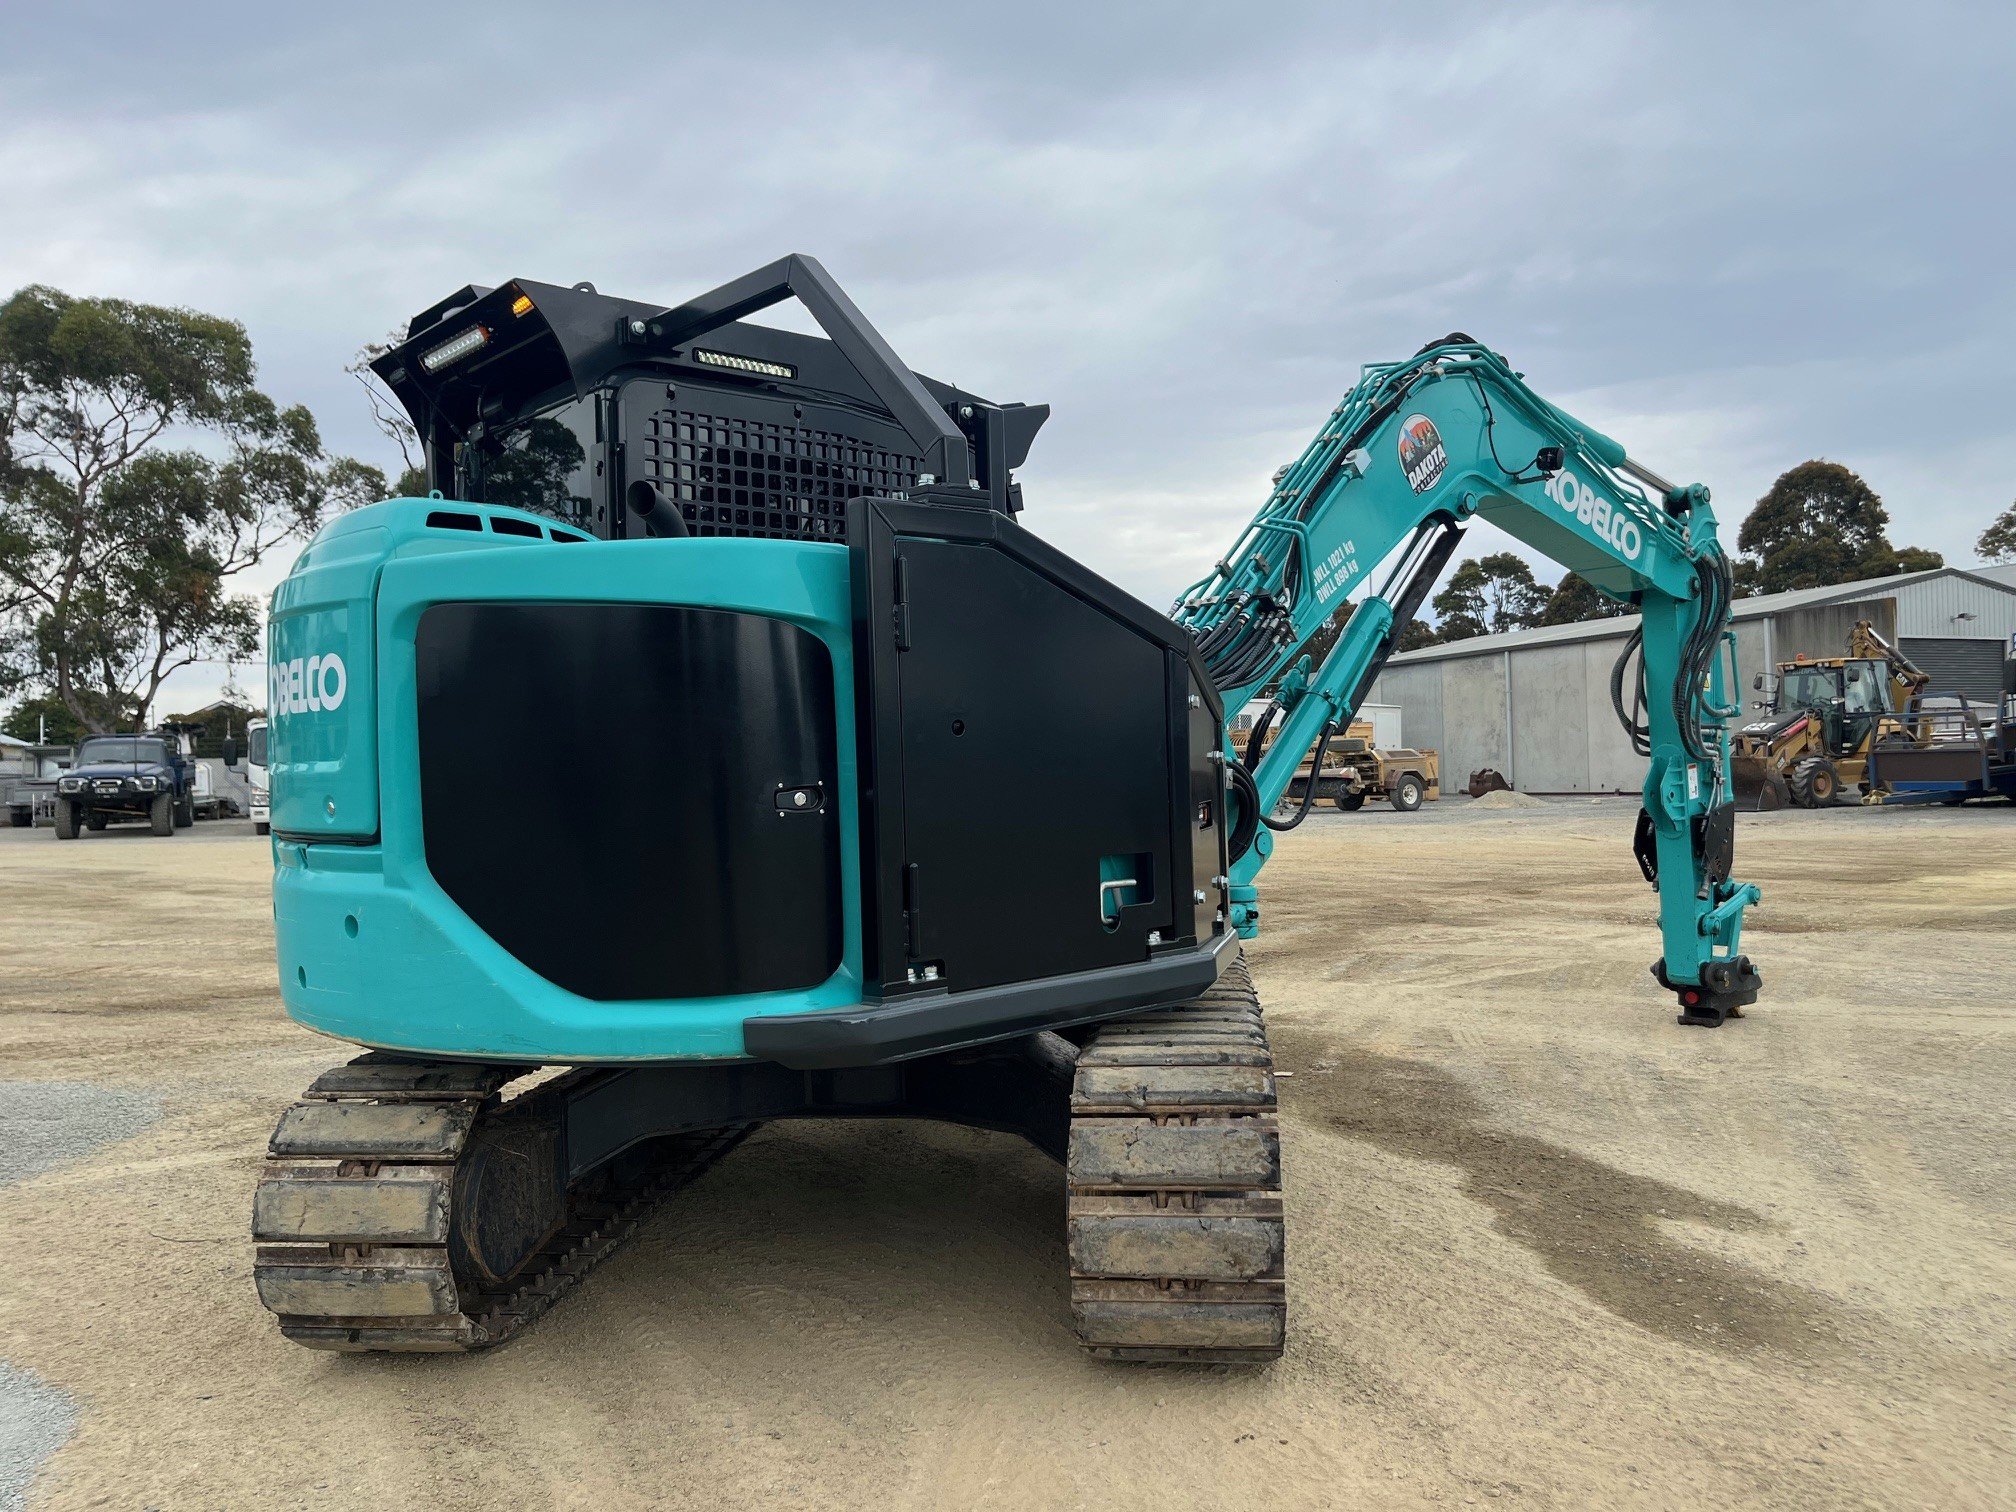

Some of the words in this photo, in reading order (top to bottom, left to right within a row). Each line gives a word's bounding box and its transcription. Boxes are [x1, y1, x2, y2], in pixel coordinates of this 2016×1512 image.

[1408, 443, 1447, 490] DAKOTA
[1544, 466, 1641, 561] KOBELCO
[1328, 546, 1345, 570] 1021
[1342, 540, 1355, 556] kg
[1316, 578, 1337, 604] DWLL
[1347, 559, 1359, 574] kg
[271, 653, 347, 718] OBELCO
